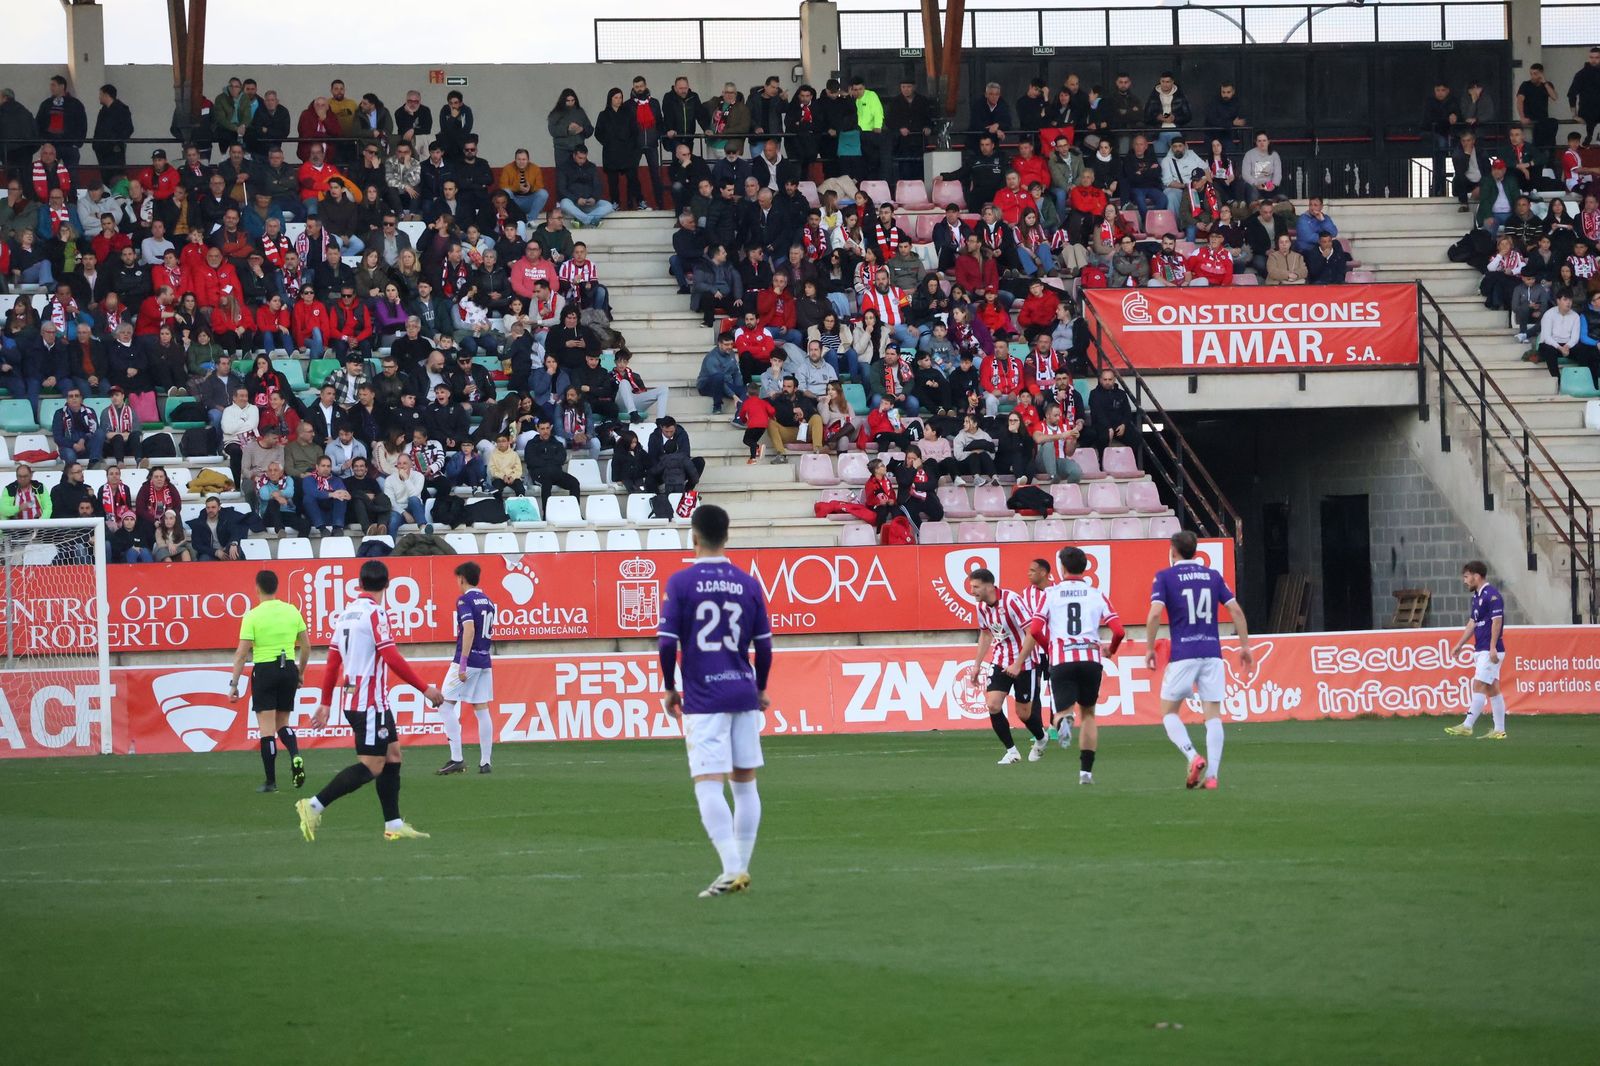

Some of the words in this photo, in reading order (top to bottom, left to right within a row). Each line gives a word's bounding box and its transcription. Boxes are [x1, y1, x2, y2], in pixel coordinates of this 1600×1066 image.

[1346, 346, 1381, 362] S.A.
[313, 565, 420, 612] fiso
[682, 553, 897, 605] MORA
[1178, 572, 1211, 581] TAVARES
[120, 587, 252, 621] ÓPTICO
[931, 576, 974, 624] ZAMORA
[1181, 588, 1213, 624] 14
[29, 621, 190, 649] ROBERTO
[481, 610, 493, 639] 10
[530, 626, 588, 635] BIOMECÁNICA
[696, 600, 743, 652] 23
[1067, 602, 1082, 636] 8
[1311, 639, 1477, 674] Escuela
[1515, 655, 1569, 671] Escucha
[1317, 676, 1488, 713] infanti
[1516, 678, 1535, 692] los
[1538, 677, 1592, 696] partidos
[499, 698, 764, 742] ZAMORA
[774, 709, 823, 733] S.L.
